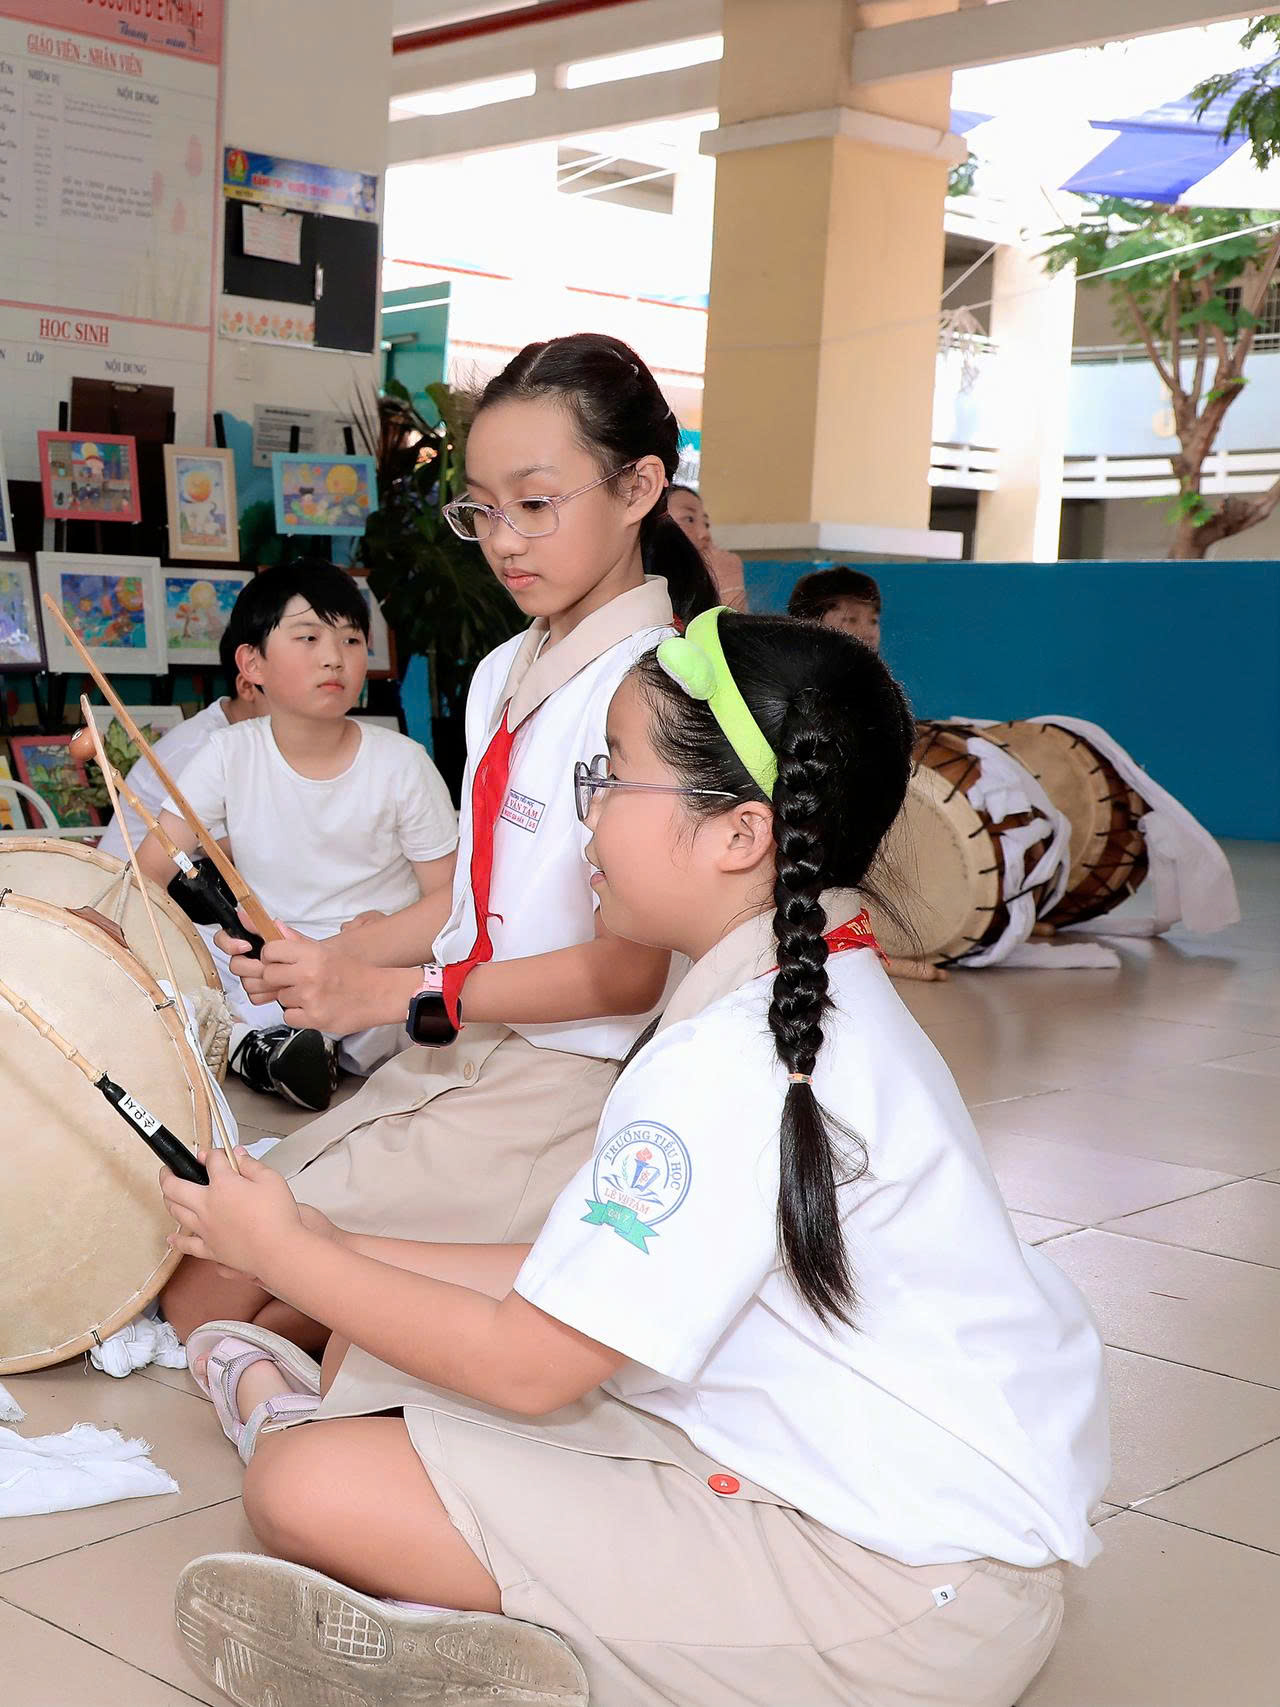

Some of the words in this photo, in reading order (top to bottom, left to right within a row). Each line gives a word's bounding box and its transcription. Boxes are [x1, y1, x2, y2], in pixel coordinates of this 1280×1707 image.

[75, 323, 109, 344] SINH
[603, 1129, 651, 1162] TRƯỜNG
[654, 1133, 678, 1158] TIỂU
[670, 1161, 683, 1191] HỌC
